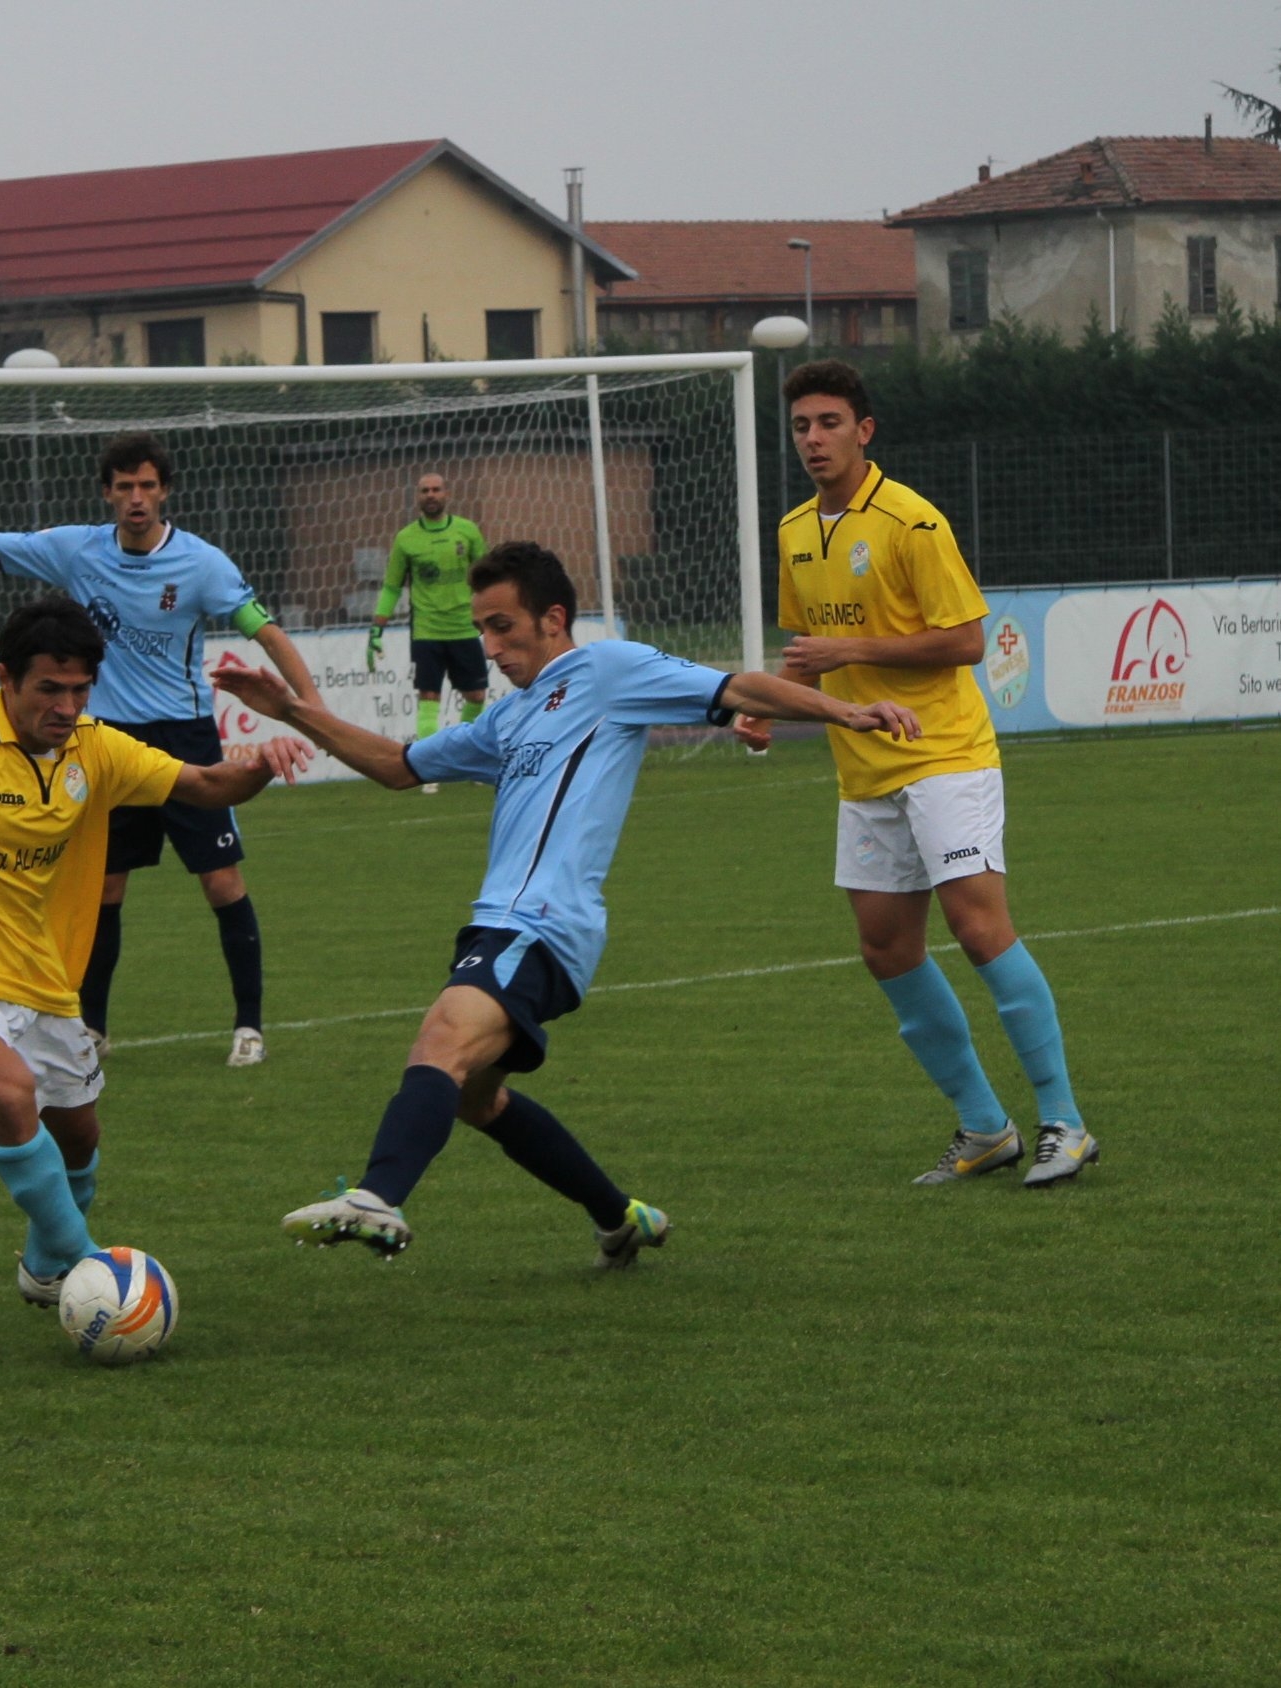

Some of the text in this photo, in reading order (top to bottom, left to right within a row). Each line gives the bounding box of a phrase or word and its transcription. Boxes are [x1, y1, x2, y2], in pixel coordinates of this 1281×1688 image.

[1213, 615, 1237, 635] Via
[1105, 683, 1185, 703] FRANZOSI
[1239, 674, 1262, 694] Sito
